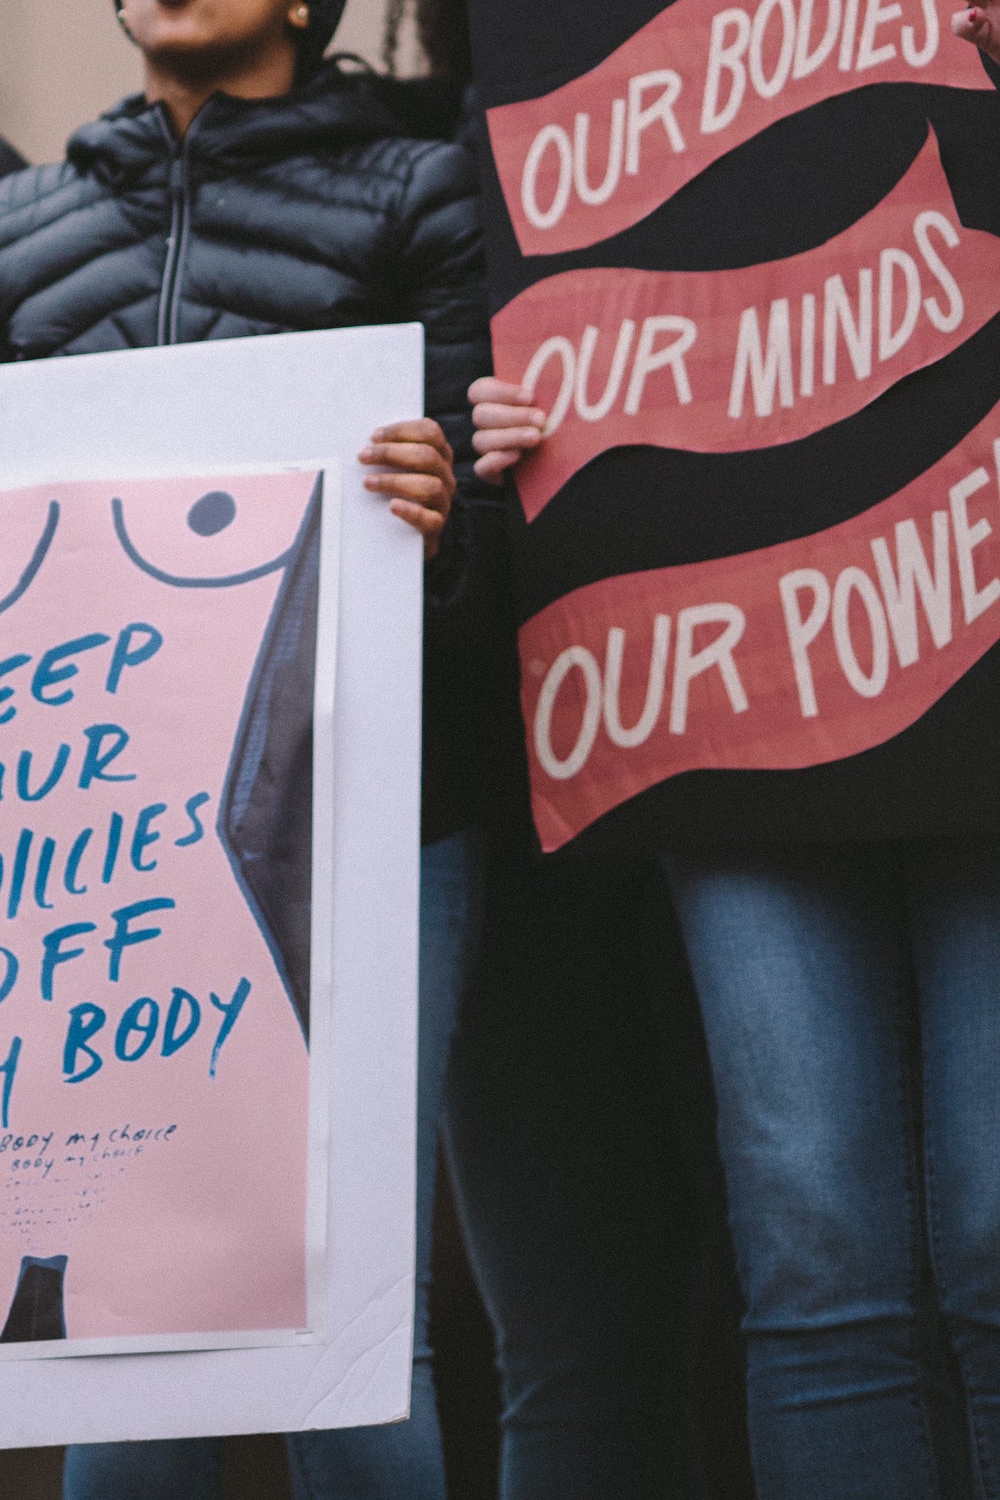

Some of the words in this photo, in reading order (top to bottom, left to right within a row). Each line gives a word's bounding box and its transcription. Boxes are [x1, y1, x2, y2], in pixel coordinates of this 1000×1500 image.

[521, 69, 686, 230] OUR
[521, 316, 697, 438] OUR
[727, 210, 965, 420] MINDS
[533, 602, 749, 781] OUR
[778, 438, 1000, 718] POWE
[62, 977, 251, 1084] BODY
